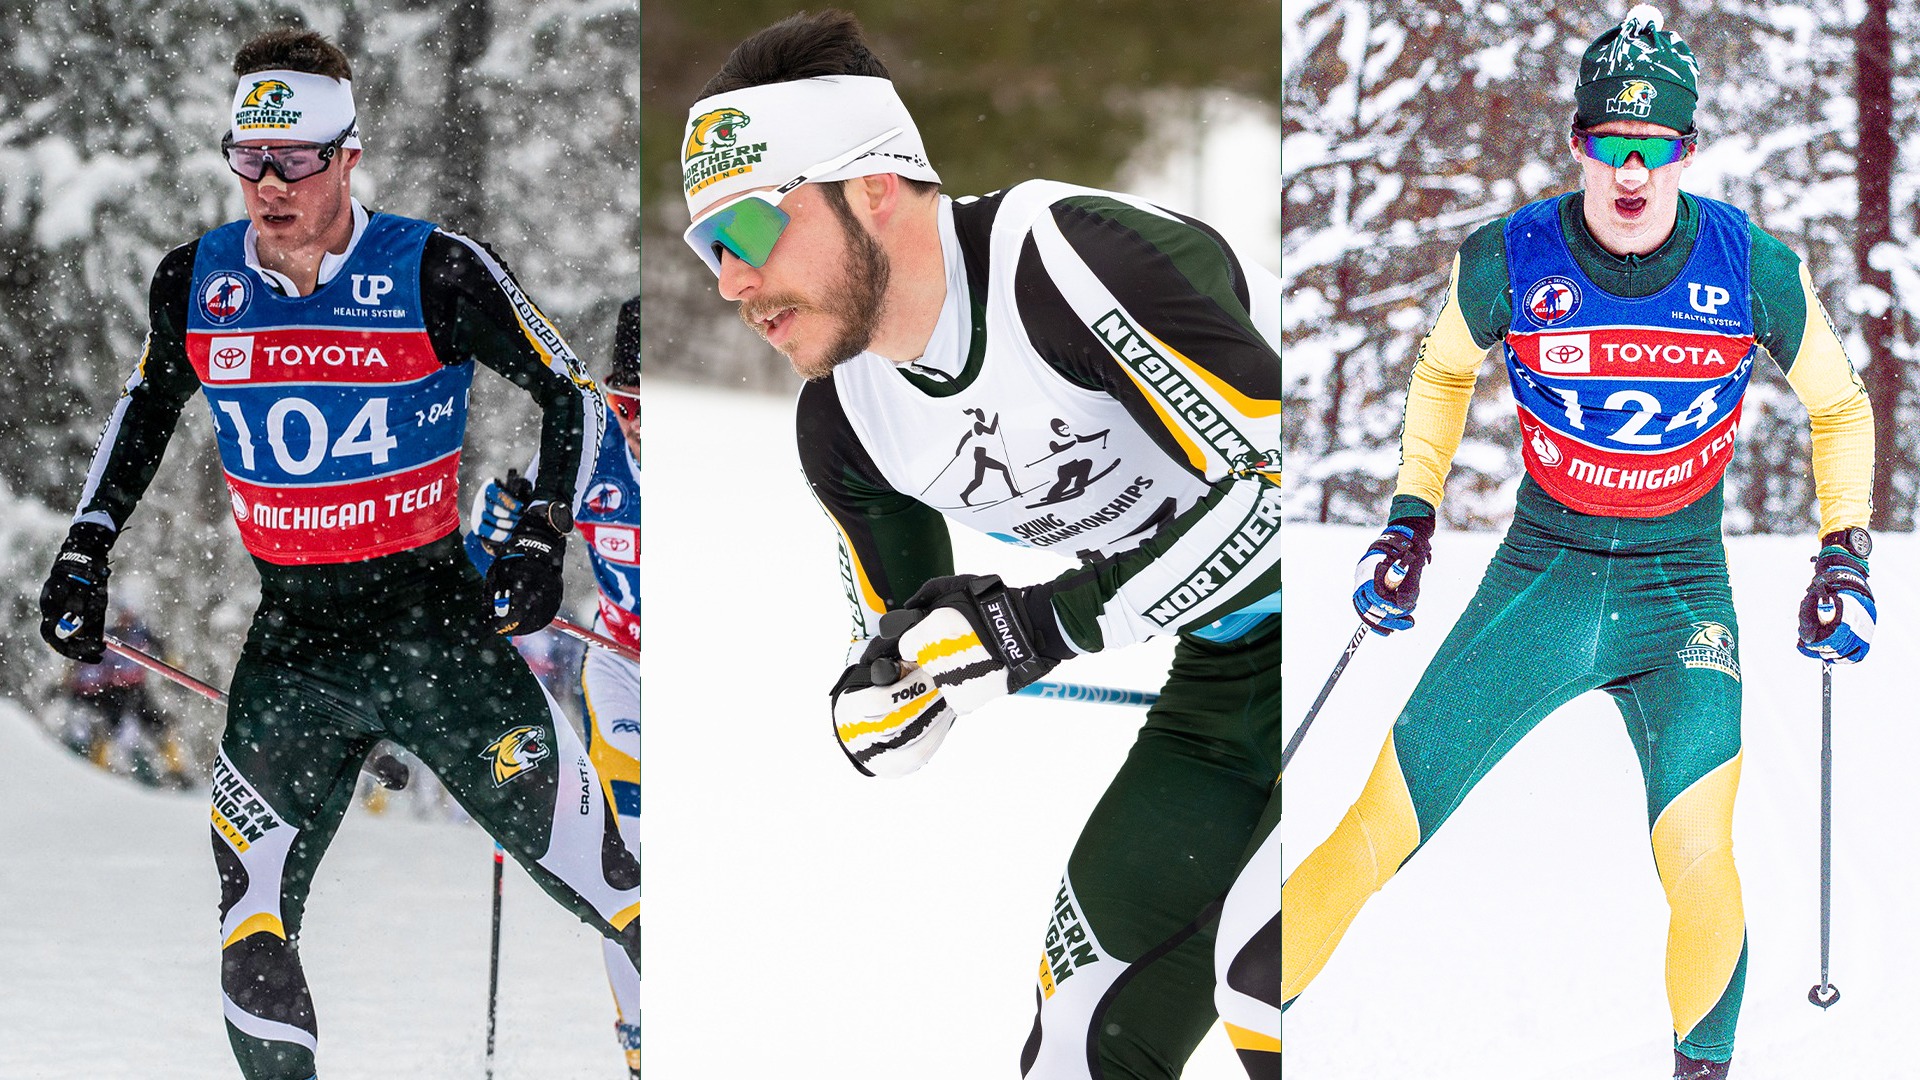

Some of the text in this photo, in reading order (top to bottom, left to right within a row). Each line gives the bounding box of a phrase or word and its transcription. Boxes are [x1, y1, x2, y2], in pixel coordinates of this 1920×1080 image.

[236, 110, 302, 118] NORTHERN
[237, 116, 297, 125] MICHIGAN
[1606, 98, 1651, 117] NMU
[685, 153, 761, 192] MICHIGAN
[691, 167, 745, 195] SKIING
[350, 274, 393, 305] UP
[1687, 282, 1730, 315] UP
[333, 307, 406, 318] HEALTH SYSTEM
[1671, 310, 1741, 328] HEALTH SYSTEM
[263, 345, 388, 367] TOYOTA
[1601, 343, 1726, 366] TOYOTA
[1097, 313, 1250, 462] MICHIGAN
[415, 396, 454, 427] 104
[1549, 385, 1721, 445] 124
[217, 397, 397, 475] 104
[1567, 458, 1694, 489] MICHIGAN
[253, 479, 443, 530] MICHIGAN TECH
[1030, 475, 1154, 547] CHAMPIONSHIPS
[1012, 513, 1066, 539] SKIING
[988, 602, 1024, 660] RUNDLE
[891, 682, 927, 704] TOKO
[580, 768, 590, 815] CRAFT
